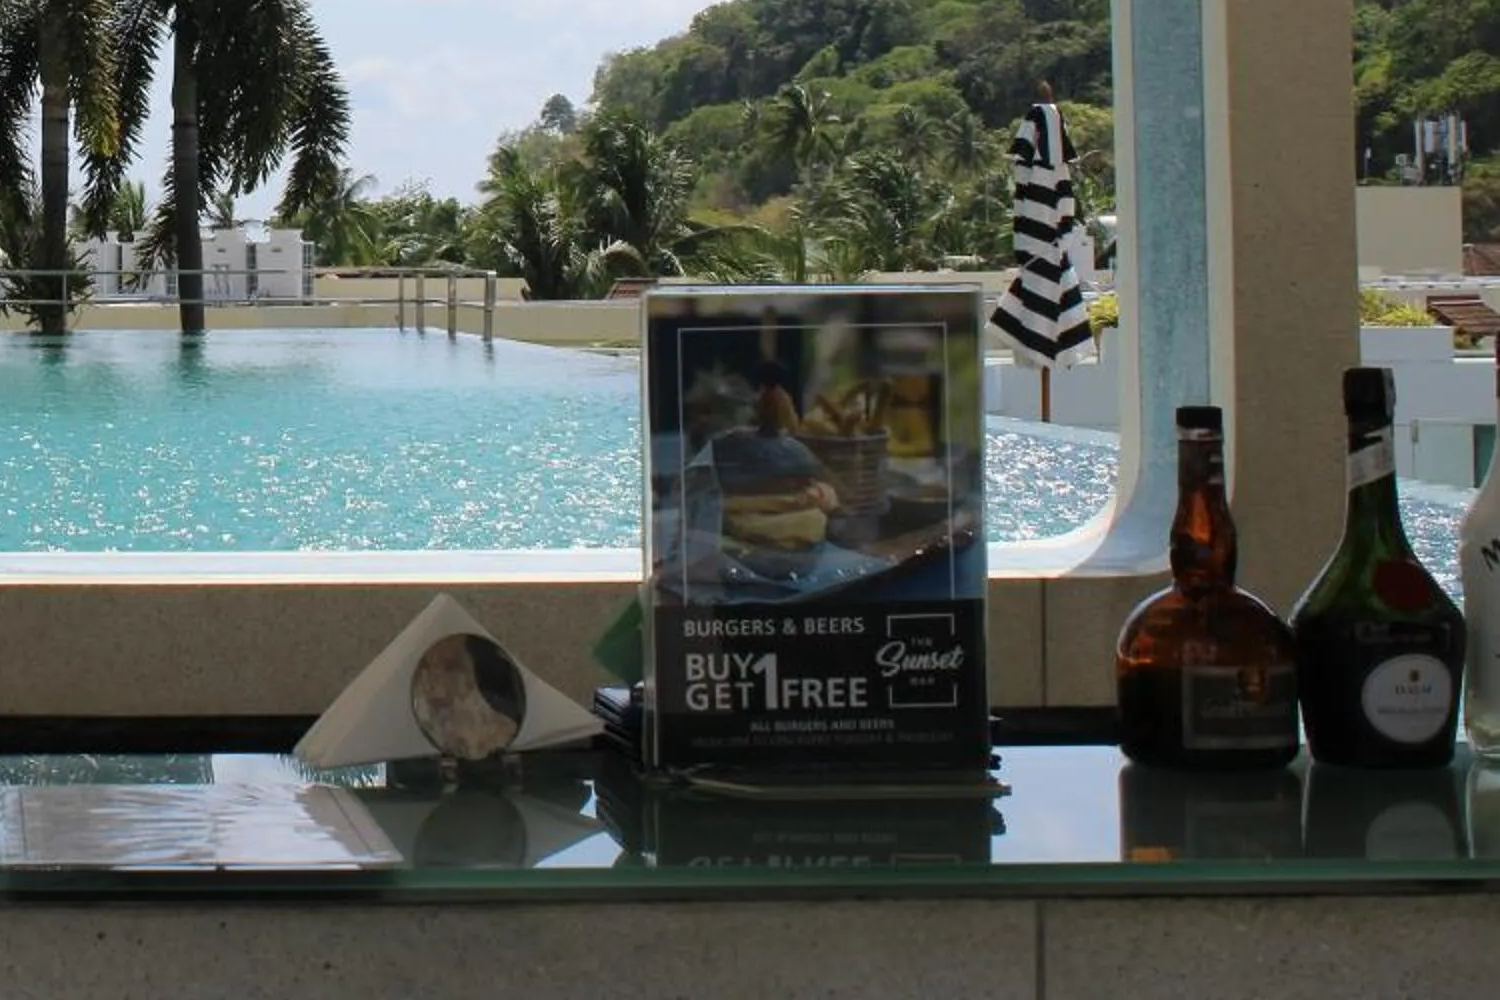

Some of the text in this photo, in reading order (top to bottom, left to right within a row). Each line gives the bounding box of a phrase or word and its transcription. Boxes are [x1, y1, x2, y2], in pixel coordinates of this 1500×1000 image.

[684, 616, 865, 638] BURGERS & BEERS
[875, 641, 965, 678] Sunset
[686, 653, 778, 710] BUY 1
[686, 677, 868, 710] GET FREE
